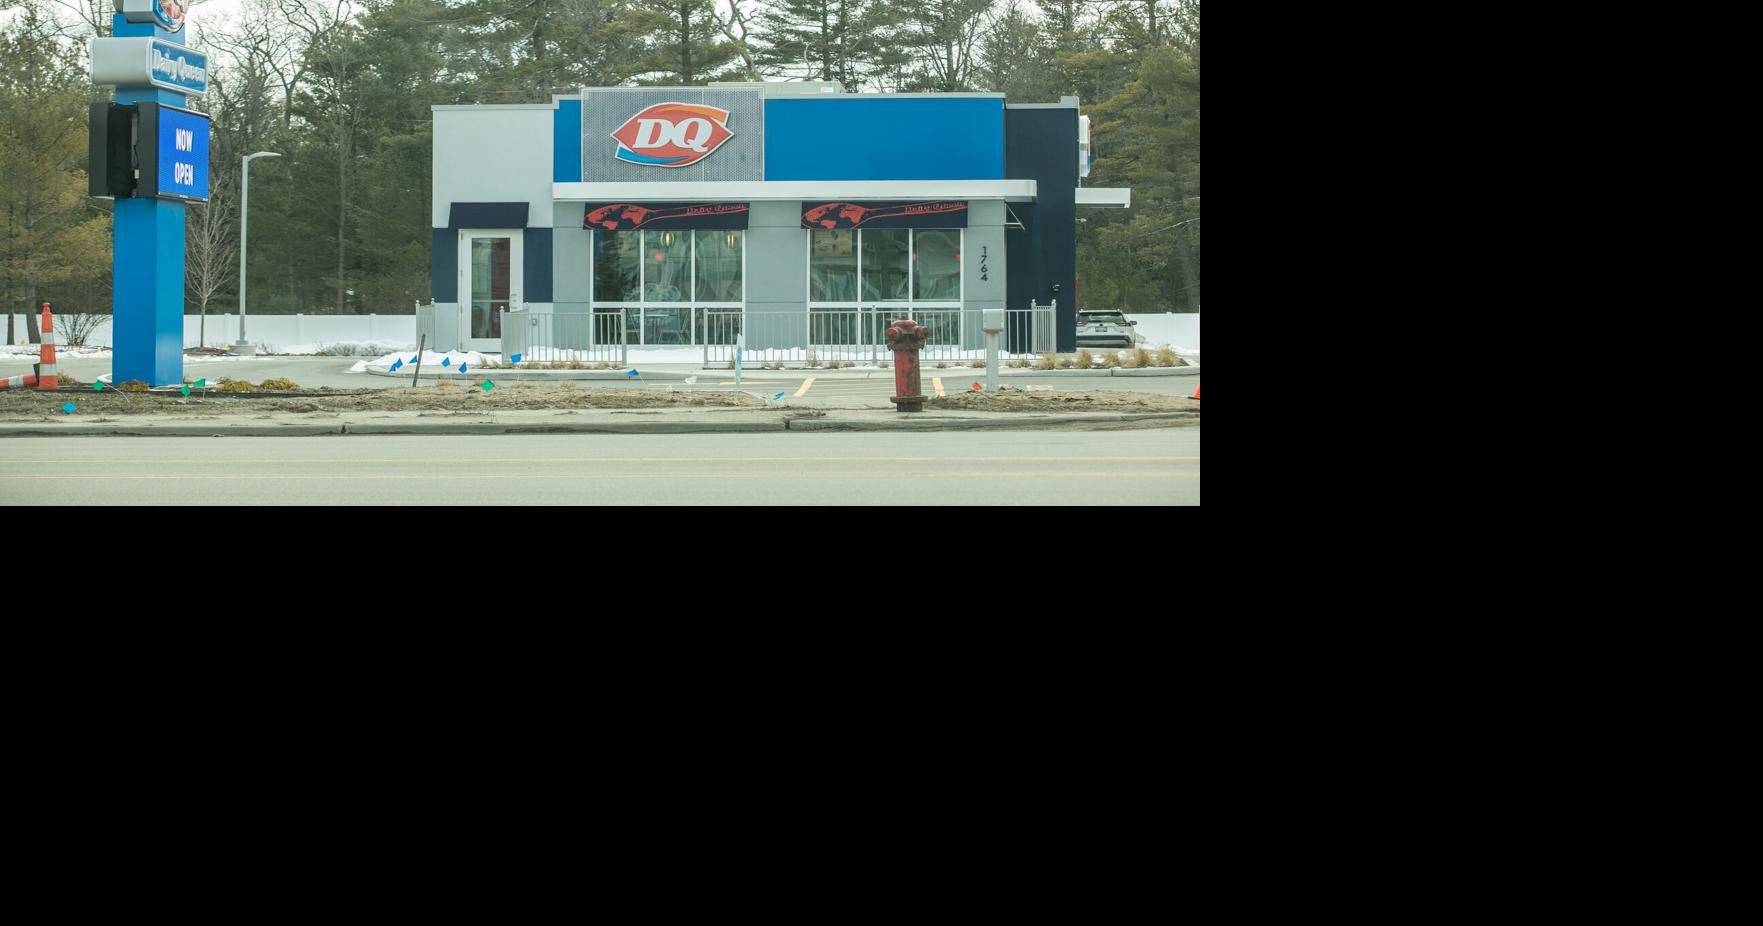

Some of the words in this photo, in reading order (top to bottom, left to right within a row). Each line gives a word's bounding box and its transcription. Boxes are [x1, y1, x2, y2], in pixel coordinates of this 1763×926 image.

[152, 48, 177, 81] Dairy
[176, 56, 205, 83] Queen
[175, 128, 193, 152] NOW
[632, 117, 713, 152] DQ
[174, 161, 194, 186] OPEN
[980, 245, 988, 281] 1764
